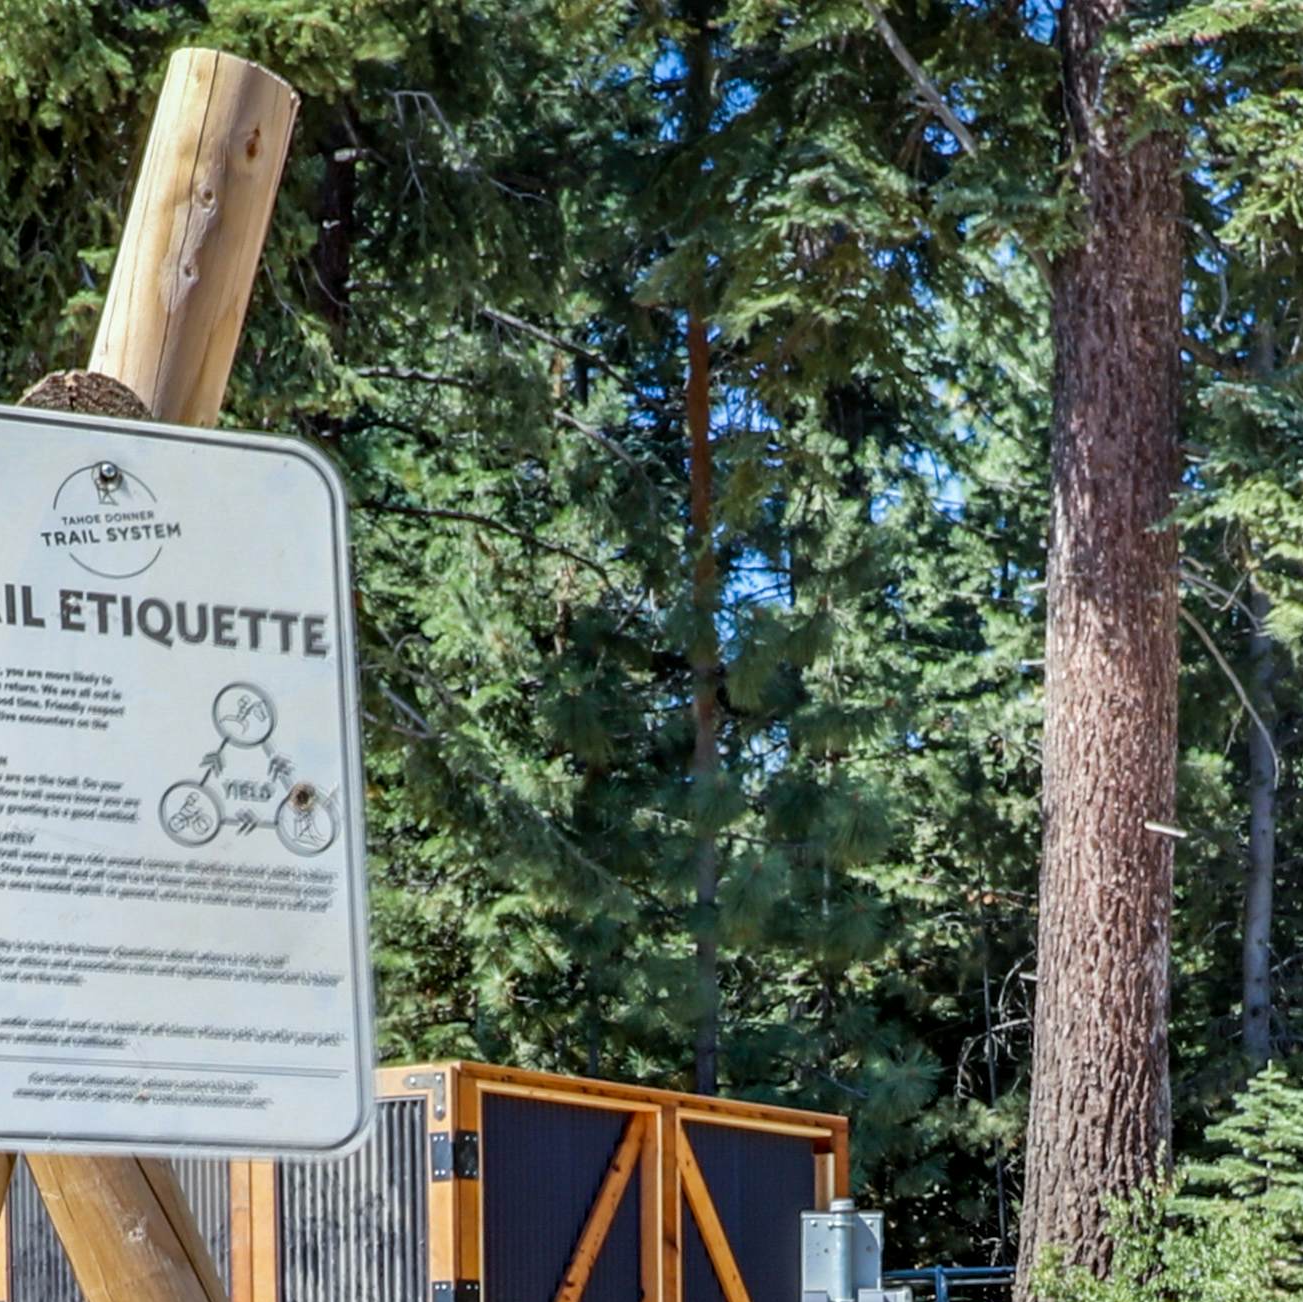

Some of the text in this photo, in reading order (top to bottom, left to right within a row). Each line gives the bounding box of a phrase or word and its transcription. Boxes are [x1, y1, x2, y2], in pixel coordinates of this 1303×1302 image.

[61, 511, 155, 526] TAHOE DONNER
[41, 523, 182, 547] TRAIL SYSTEM
[60, 588, 329, 658] ETIQUETTE
